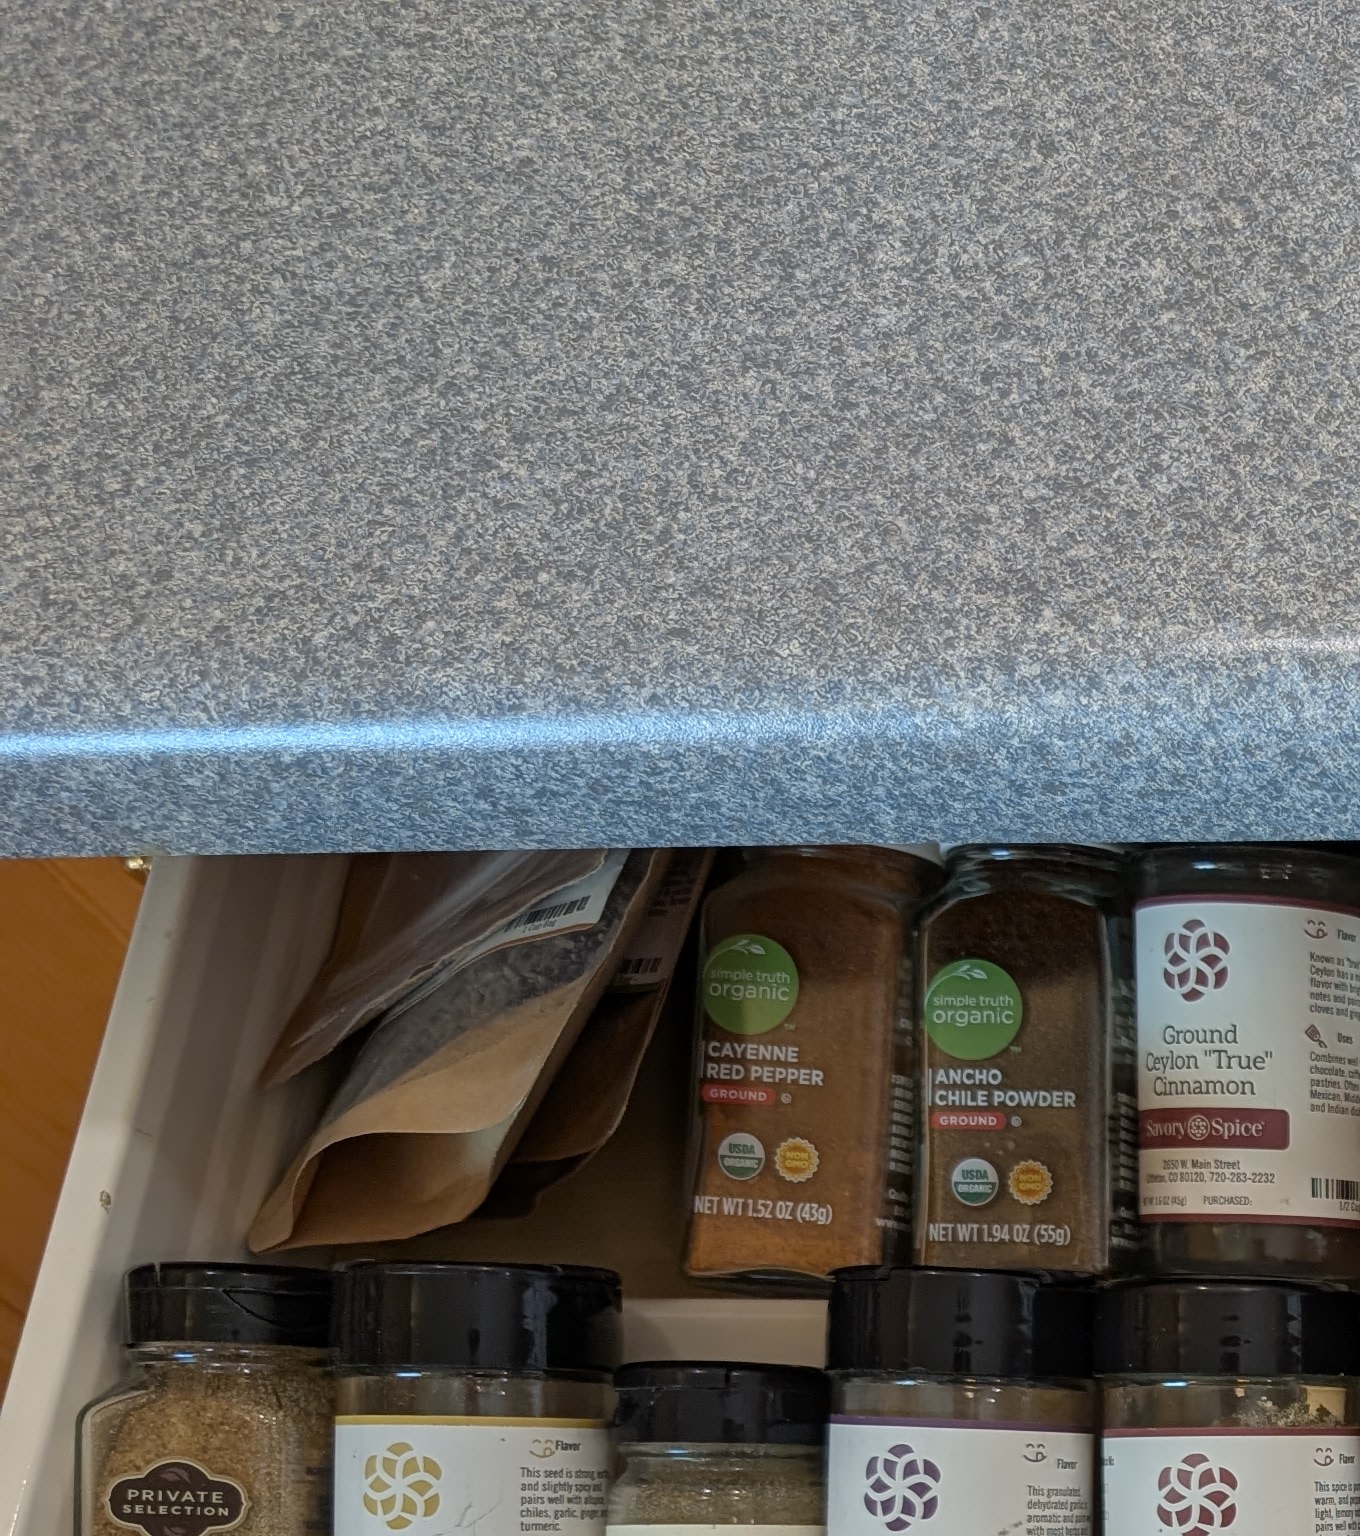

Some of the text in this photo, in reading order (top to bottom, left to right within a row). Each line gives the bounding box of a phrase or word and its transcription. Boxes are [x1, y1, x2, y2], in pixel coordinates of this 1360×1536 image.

[708, 982, 790, 1002] organic
[1162, 1024, 1239, 1045] Ground
[707, 1041, 799, 1063] CAYENNE
[1145, 1051, 1274, 1074] Ceylon "True"
[707, 1064, 825, 1087] RED PEPPER
[935, 1069, 1002, 1086] ANCHO
[709, 1088, 767, 1101] GROUND
[1153, 1077, 1256, 1097] Cinnamon
[935, 1089, 1077, 1108] CHILE POWDER
[127, 1489, 224, 1504] PRIVATE
[122, 1504, 230, 1517] SELECTION
